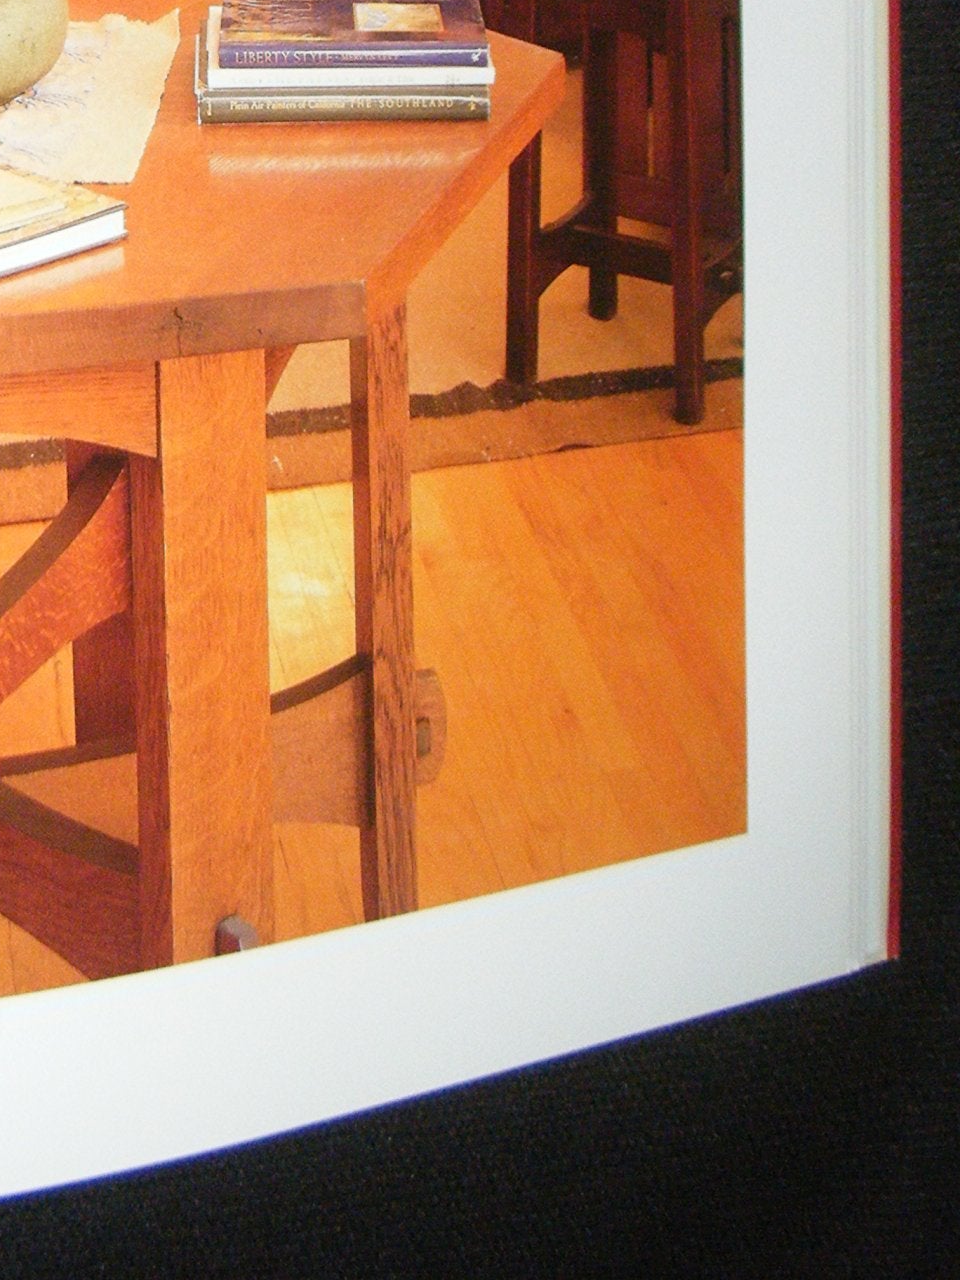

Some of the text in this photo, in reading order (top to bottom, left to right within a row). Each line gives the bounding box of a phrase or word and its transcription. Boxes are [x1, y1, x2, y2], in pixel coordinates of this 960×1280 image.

[234, 49, 290, 64] LIBERTY
[293, 49, 334, 64] STYLE
[350, 97, 372, 109] THE
[378, 96, 454, 109] SOUTHLAND
